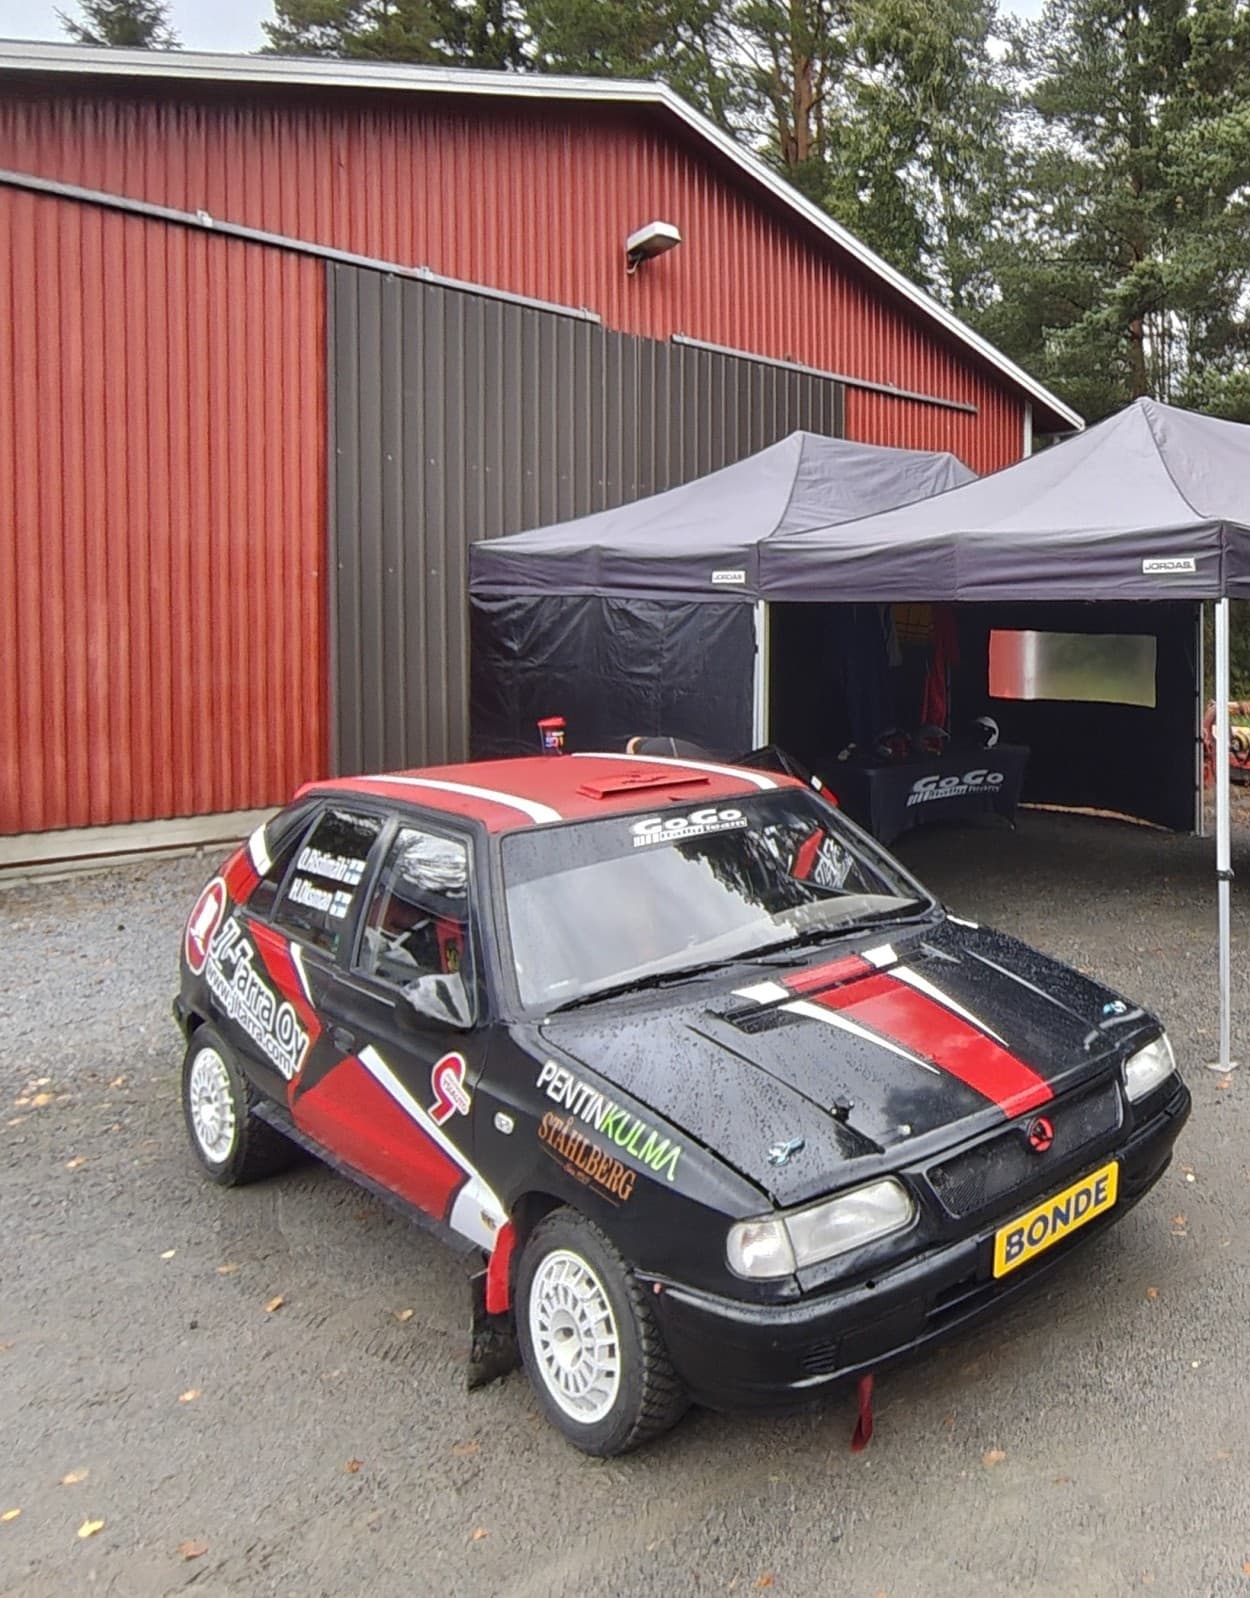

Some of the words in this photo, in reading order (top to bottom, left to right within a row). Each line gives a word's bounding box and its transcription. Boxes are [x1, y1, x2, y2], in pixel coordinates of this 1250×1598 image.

[912, 768, 1004, 793] GoGo
[630, 808, 742, 836] GoGo
[275, 1002, 310, 1072] Oy
[537, 1111, 637, 1201] STÅHLBERG
[1005, 1173, 1110, 1265] BONDE
